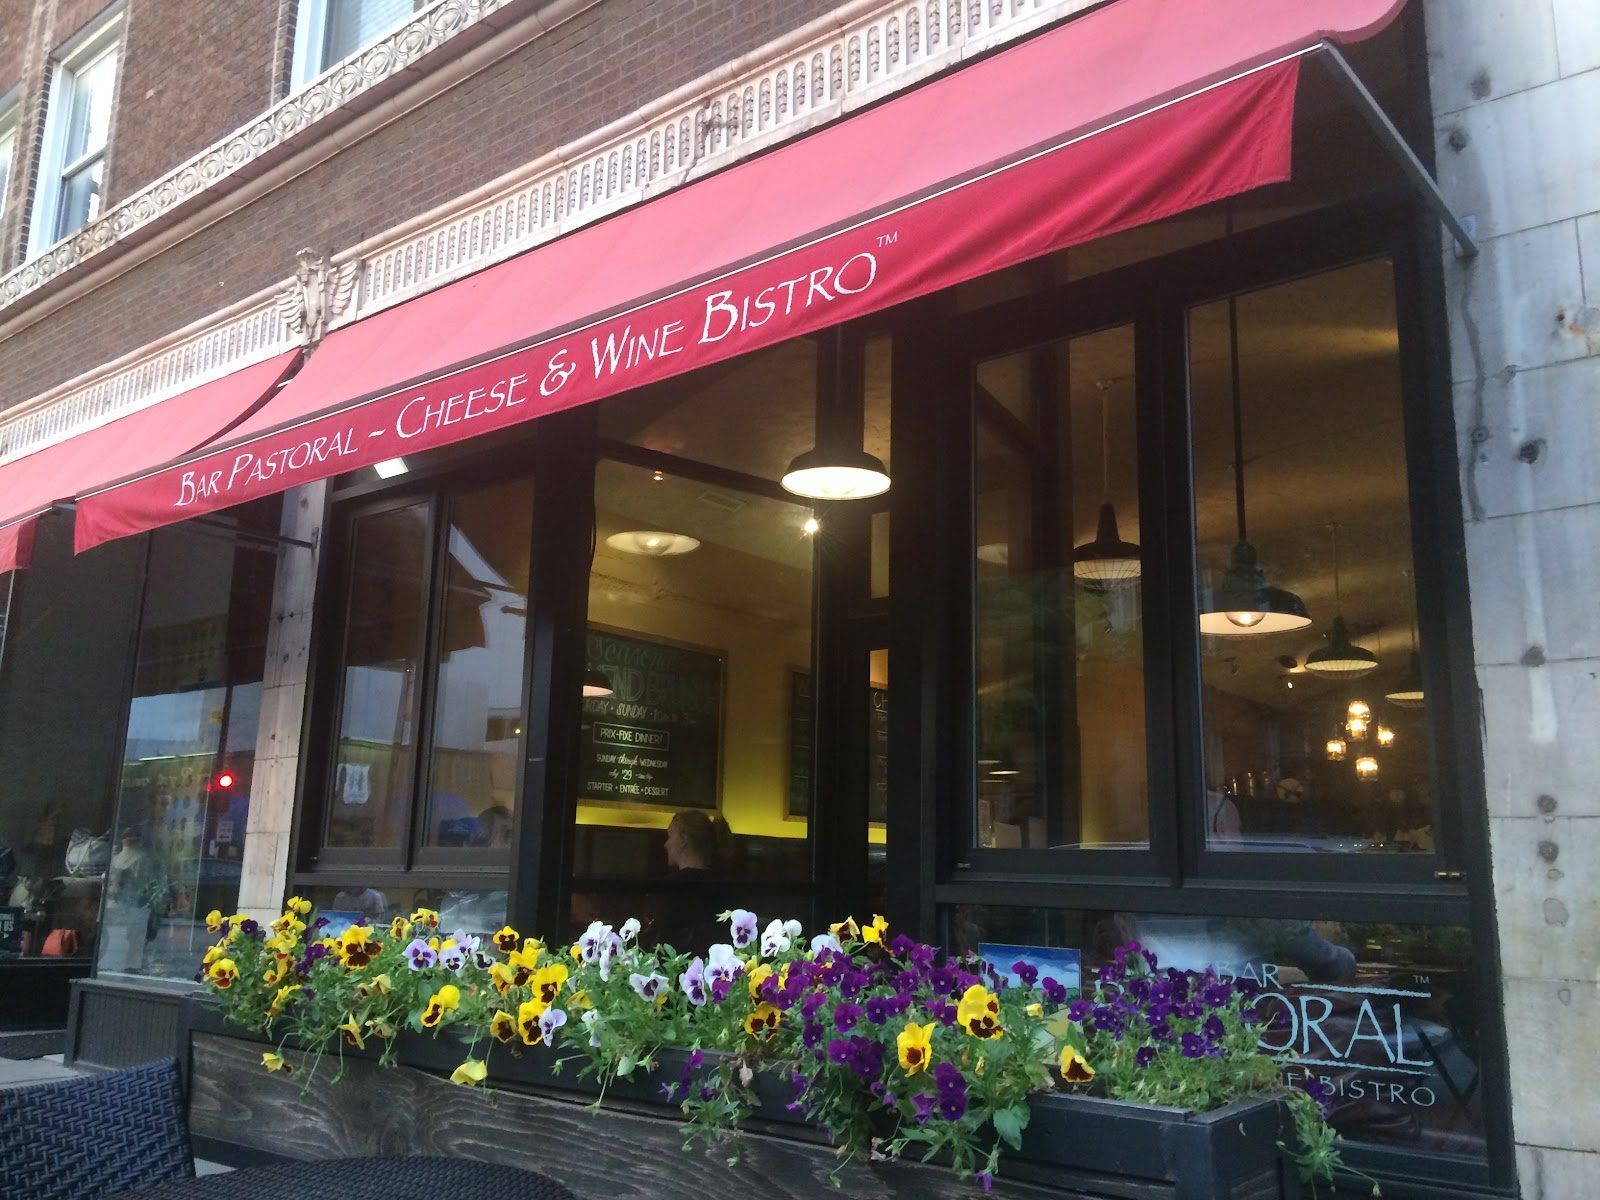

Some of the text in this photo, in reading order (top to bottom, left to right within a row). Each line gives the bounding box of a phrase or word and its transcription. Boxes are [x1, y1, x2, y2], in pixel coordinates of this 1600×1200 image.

[227, 428, 358, 490] PASTORAL
[395, 373, 528, 439] CHEESE
[539, 349, 577, 397] &
[591, 319, 685, 379] WINE
[698, 252, 877, 345] BISTRO
[616, 702, 648, 719] SUNDAY
[586, 781, 613, 792] STARTER
[644, 786, 669, 796] DESSERT
[1319, 1075, 1436, 1107] BISTRO
